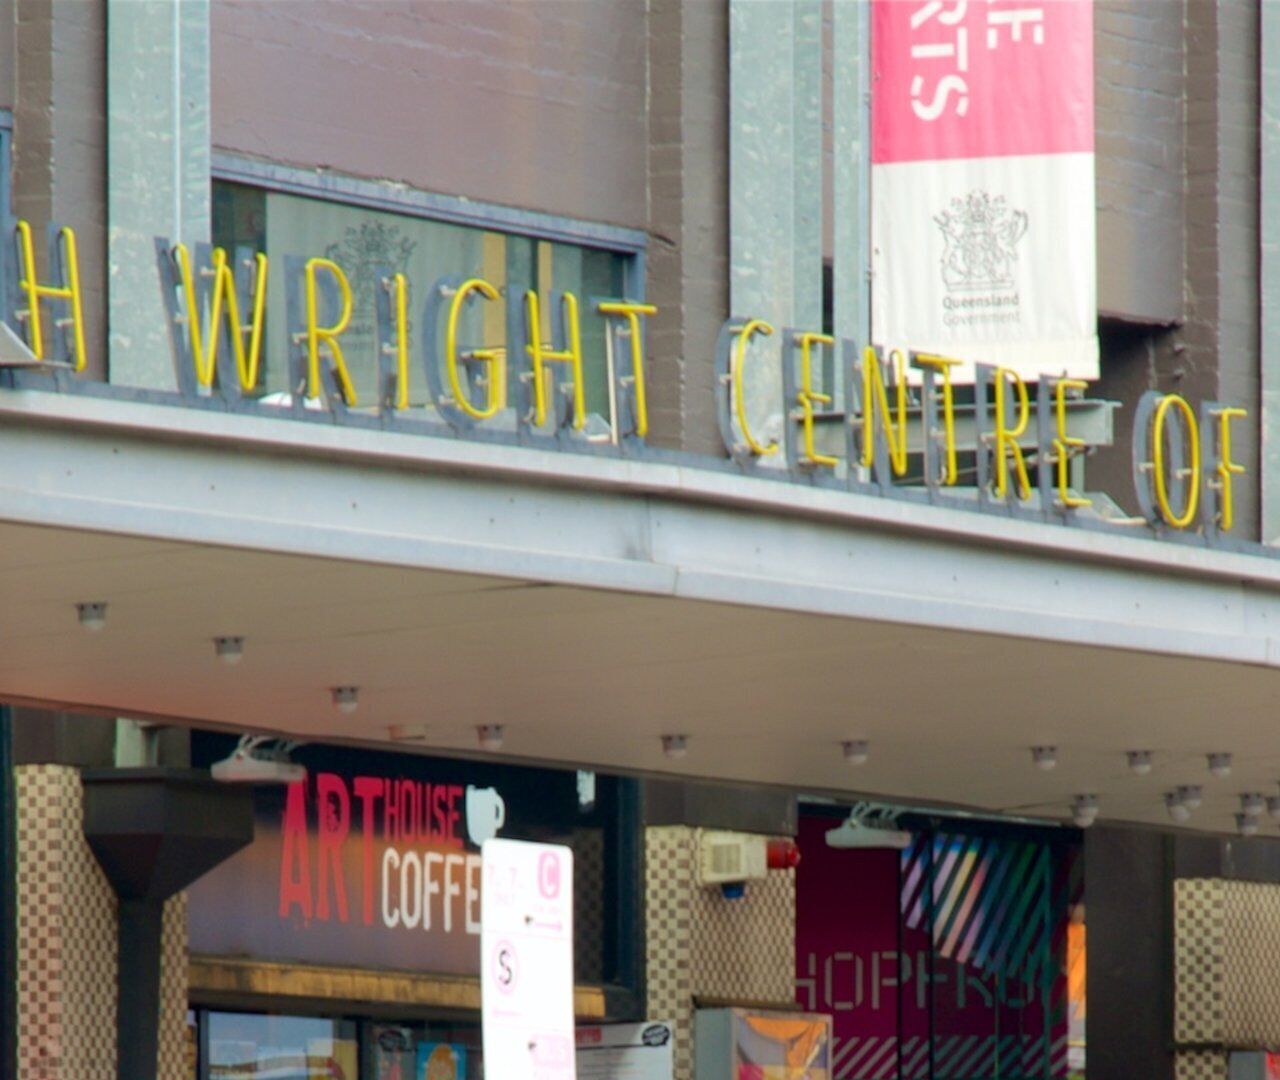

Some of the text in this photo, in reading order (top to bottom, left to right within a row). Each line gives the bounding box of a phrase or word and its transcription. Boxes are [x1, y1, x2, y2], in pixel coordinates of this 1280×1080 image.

[942, 292, 1020, 310] Queensland
[943, 310, 1021, 327] Government
[154, 236, 658, 440] WRIGHT
[717, 317, 1091, 508] CENTRE
[1133, 391, 1247, 532] OF
[383, 777, 465, 848] HOUSE
[278, 768, 386, 929] ART
